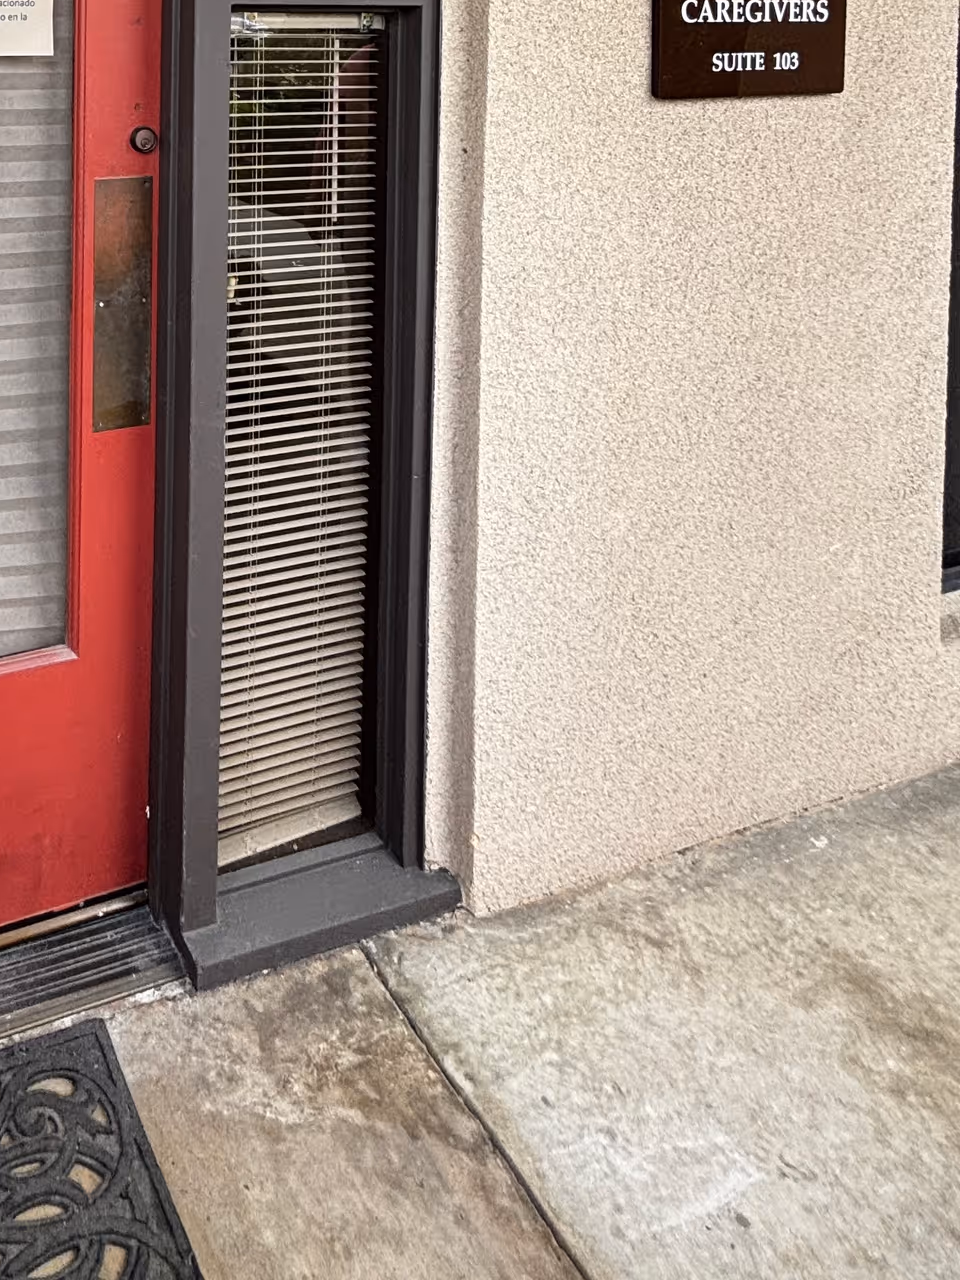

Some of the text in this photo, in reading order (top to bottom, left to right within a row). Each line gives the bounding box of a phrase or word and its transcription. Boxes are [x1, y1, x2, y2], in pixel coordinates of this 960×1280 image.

[21, 13, 27, 21] la
[681, 0, 829, 23] CAREGIVERS
[712, 52, 798, 72] SUITE 103
